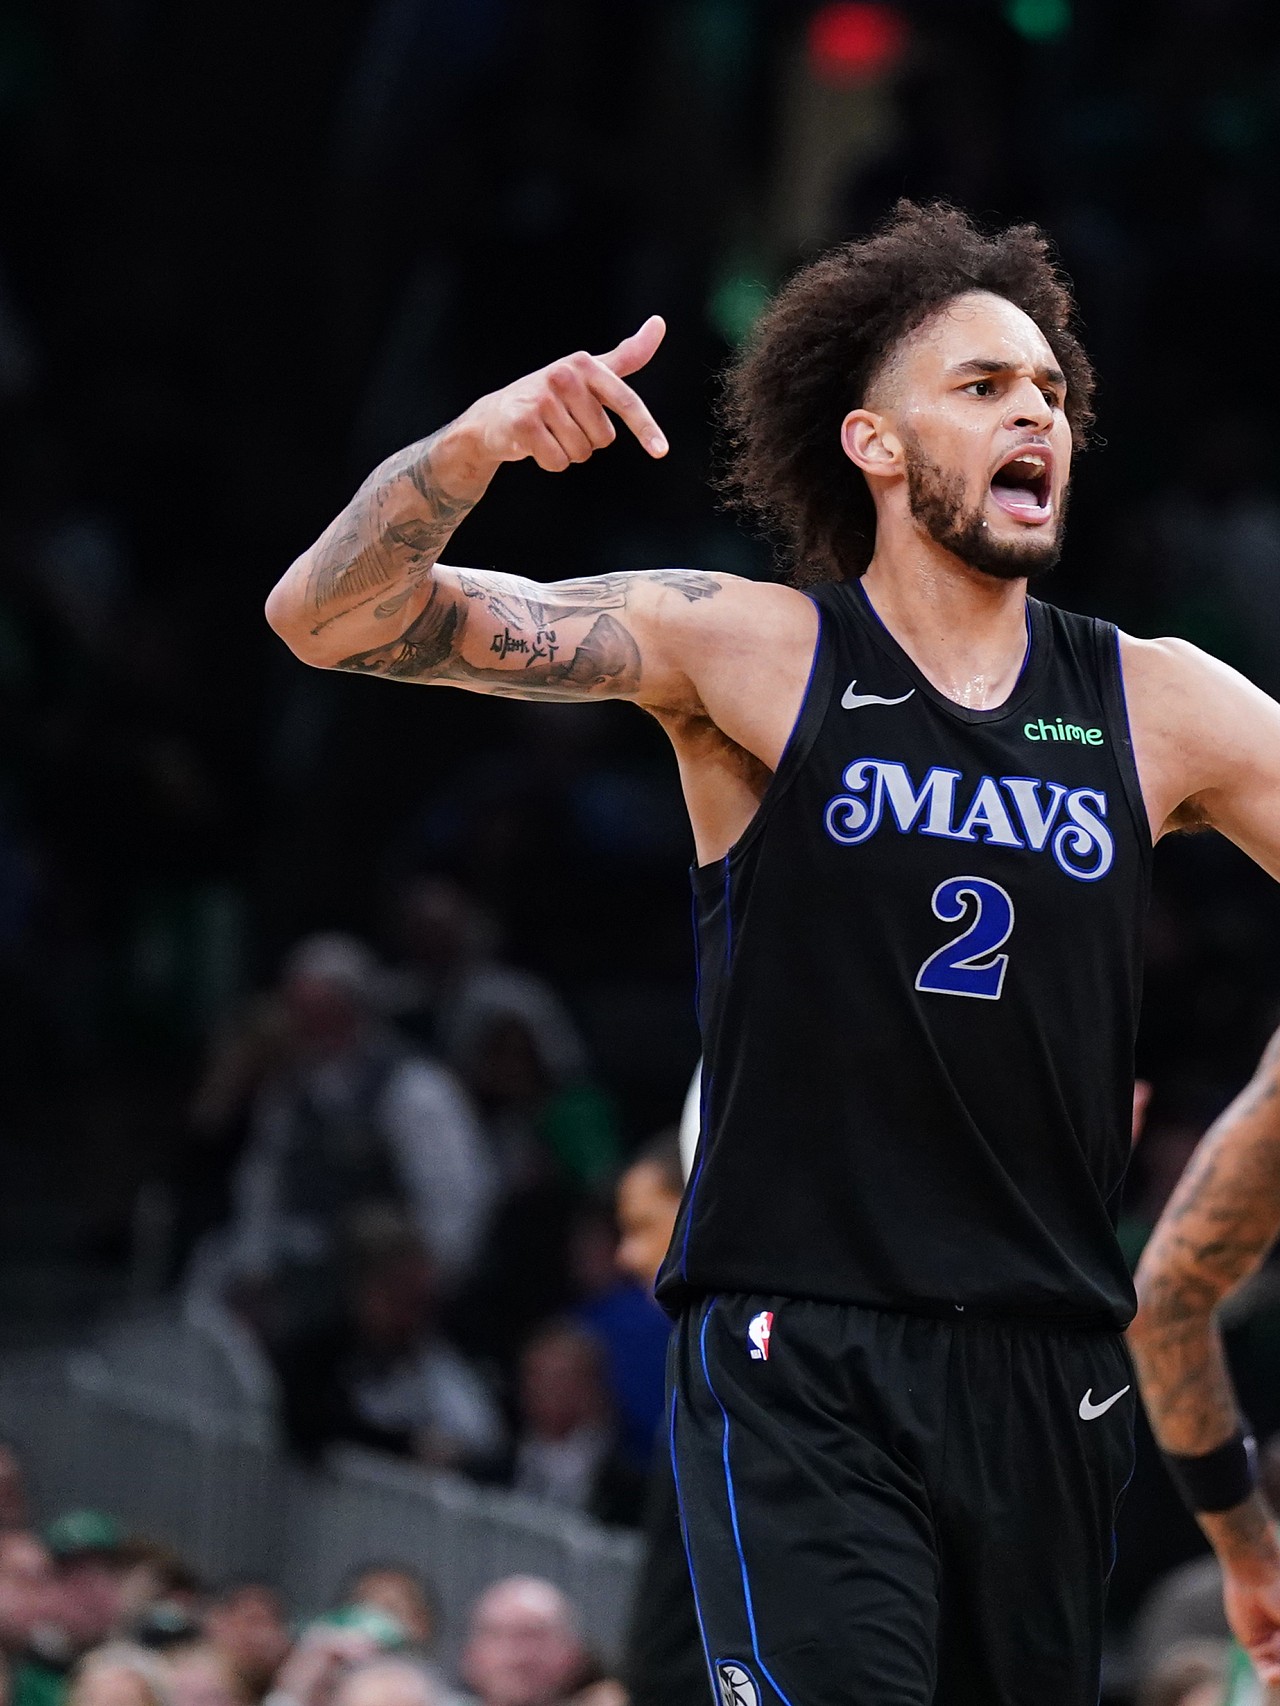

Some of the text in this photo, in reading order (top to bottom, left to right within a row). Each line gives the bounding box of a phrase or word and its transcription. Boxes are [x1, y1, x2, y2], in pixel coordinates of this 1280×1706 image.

[1023, 717, 1104, 746] chime
[824, 757, 1116, 883] MAVS
[914, 875, 1015, 1001] 2
